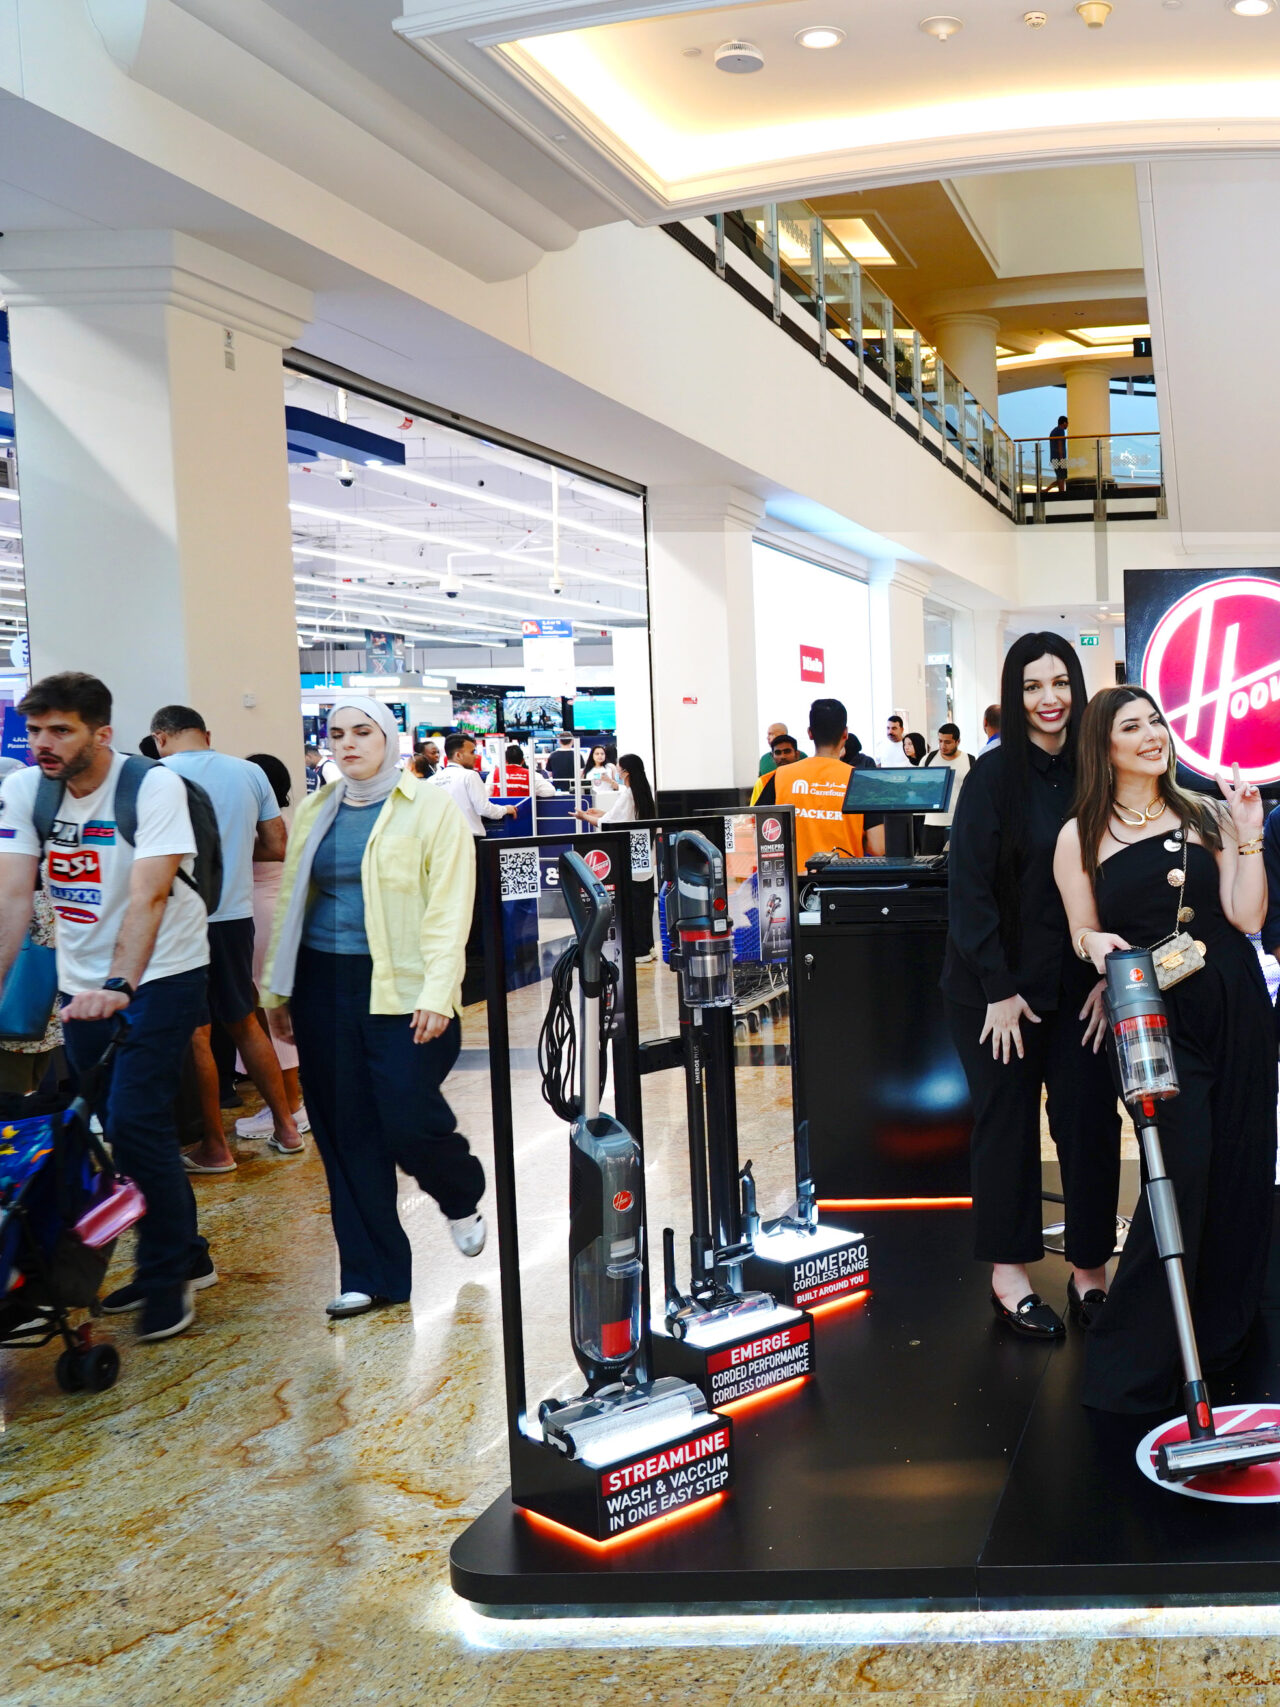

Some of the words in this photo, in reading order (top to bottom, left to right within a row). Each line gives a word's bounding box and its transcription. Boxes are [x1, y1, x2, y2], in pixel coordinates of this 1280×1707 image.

[795, 807, 843, 821] PACKER
[793, 1268, 839, 1291] CORDLESS
[840, 1258, 869, 1277] RANGE
[794, 1244, 868, 1281] HOMEPRO
[796, 1289, 819, 1304] BUILT
[818, 1280, 849, 1297] AROUND
[849, 1274, 864, 1286] YOU
[711, 1365, 747, 1389] CORDED
[748, 1342, 809, 1376] PERFORMANCE
[730, 1331, 791, 1365] EMERGE
[712, 1378, 755, 1405] CORDLESS
[755, 1358, 810, 1389] CONVENIENCE
[609, 1431, 725, 1491] STREAMLINE
[606, 1484, 652, 1514] WASH
[655, 1479, 667, 1495] &
[669, 1453, 729, 1488] VACCUM
[609, 1515, 625, 1532] IN
[628, 1499, 657, 1523] ONE
[660, 1485, 693, 1510] EASY
[695, 1470, 729, 1495] STEP
